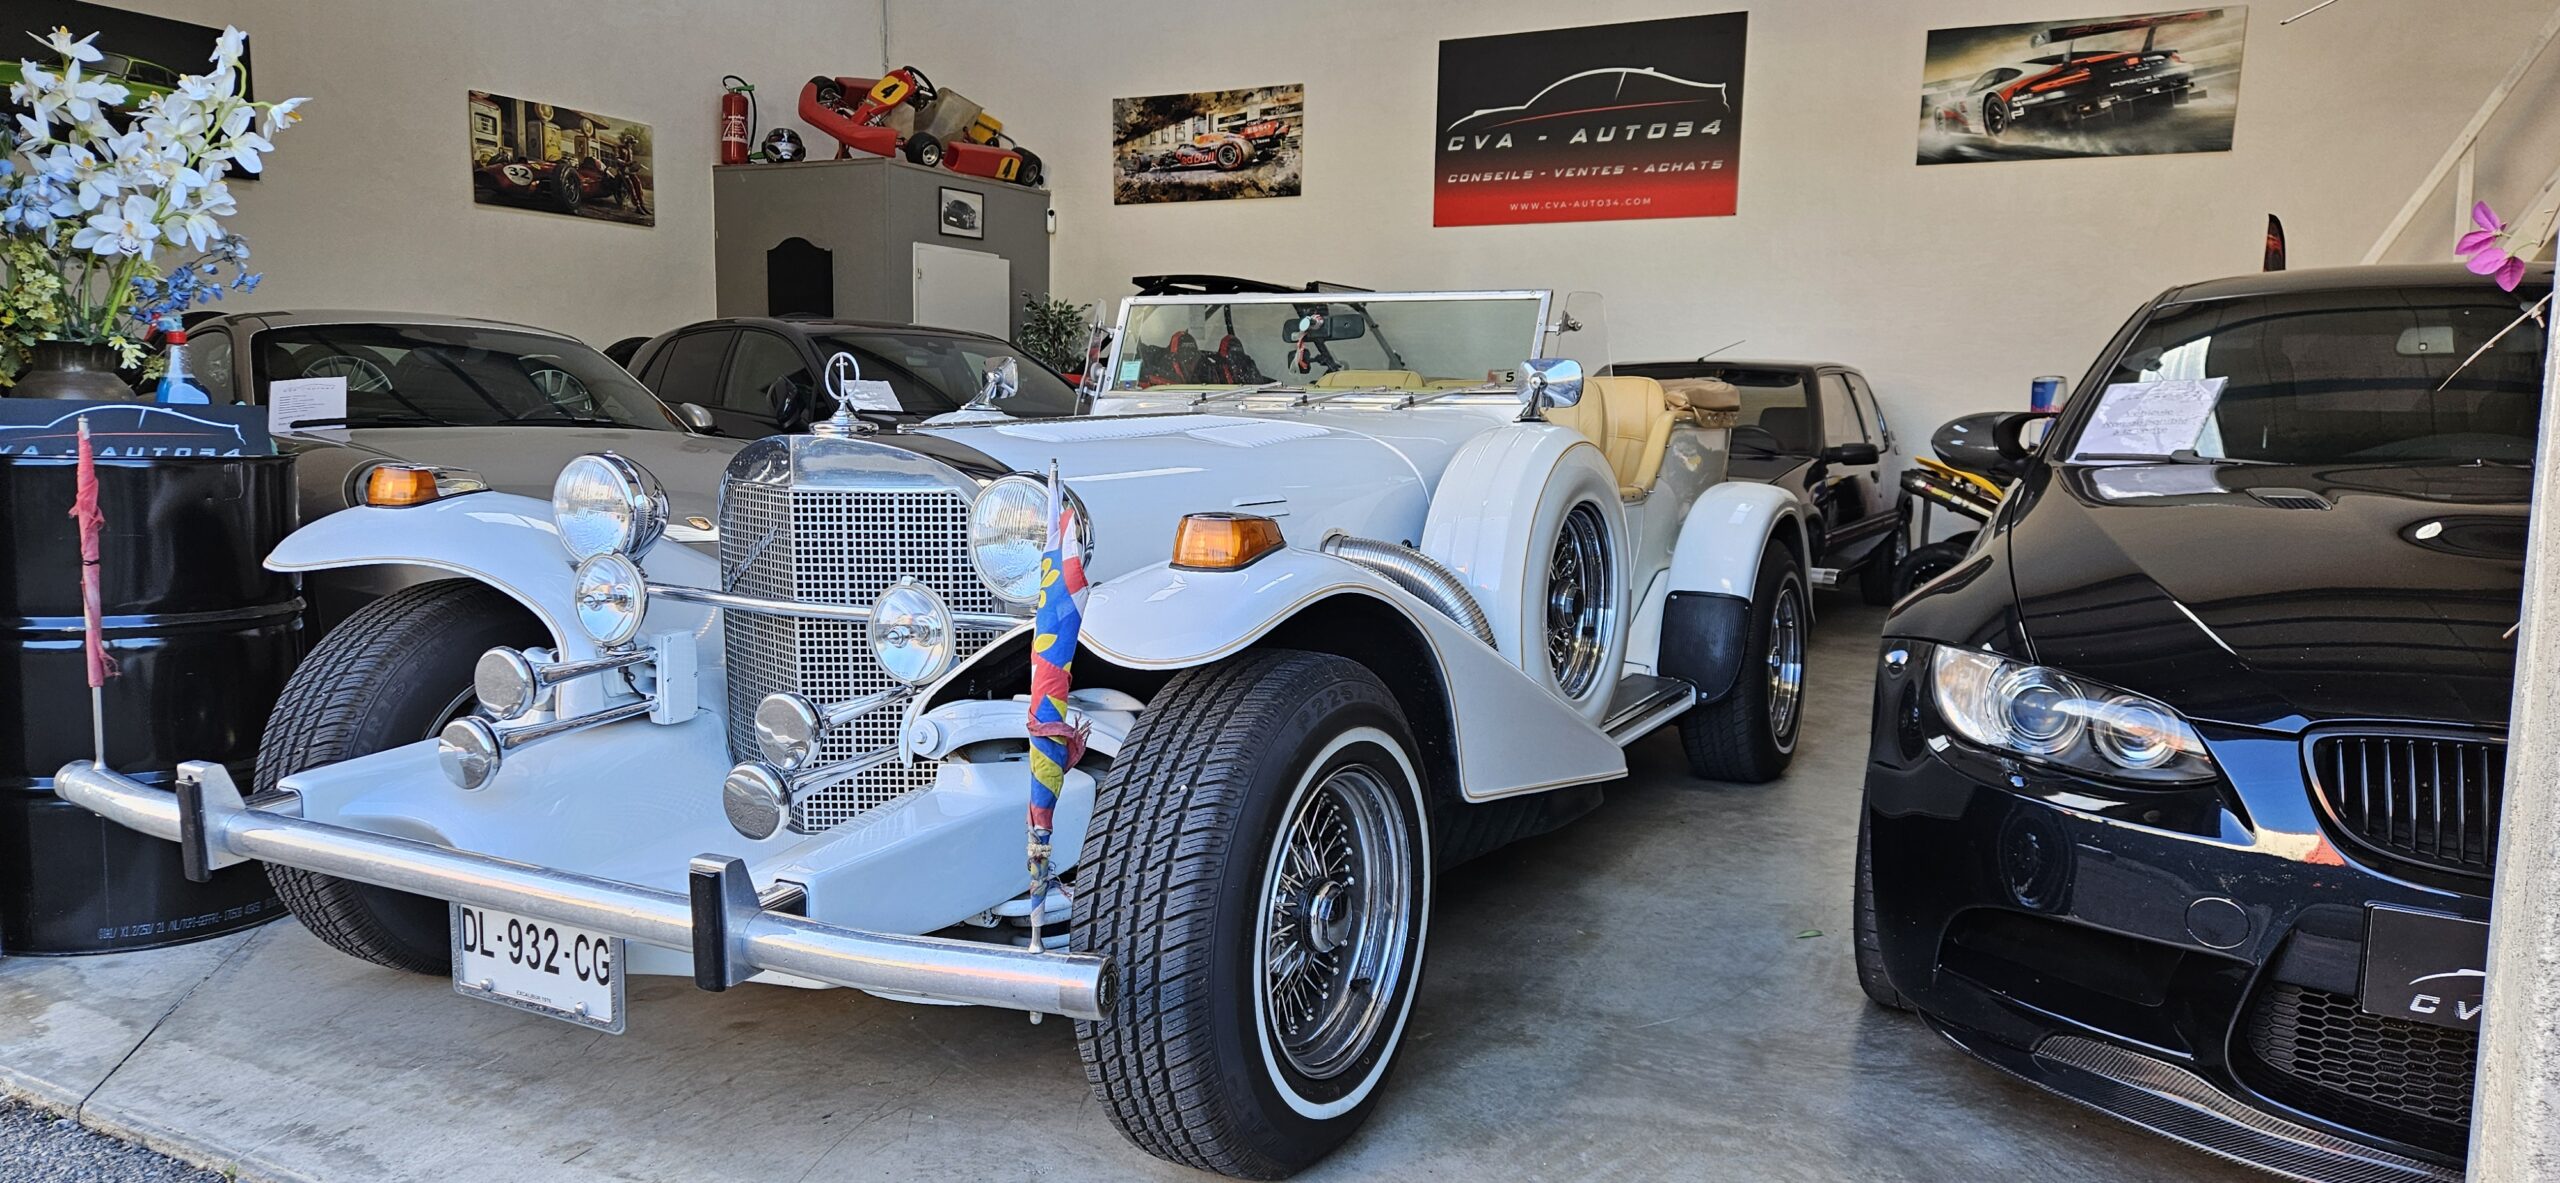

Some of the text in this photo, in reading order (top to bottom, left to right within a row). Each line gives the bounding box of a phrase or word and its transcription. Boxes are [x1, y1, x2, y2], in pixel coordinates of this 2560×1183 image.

[881, 84, 899, 99] 4
[1448, 133, 1513, 151] CVA
[1570, 120, 1722, 145] AUTO34
[508, 167, 530, 180] 32
[1002, 158, 1014, 178] 4
[1447, 169, 1534, 183] CONSEILS
[1554, 165, 1625, 178] VENTES
[1644, 160, 1724, 174] ACHATS
[1510, 197, 1652, 211] WWW.CVA-AUTO34.COM
[1505, 372, 1515, 383] 5
[463, 907, 610, 986] DL-932-CG
[2410, 994, 2483, 1020] CV
